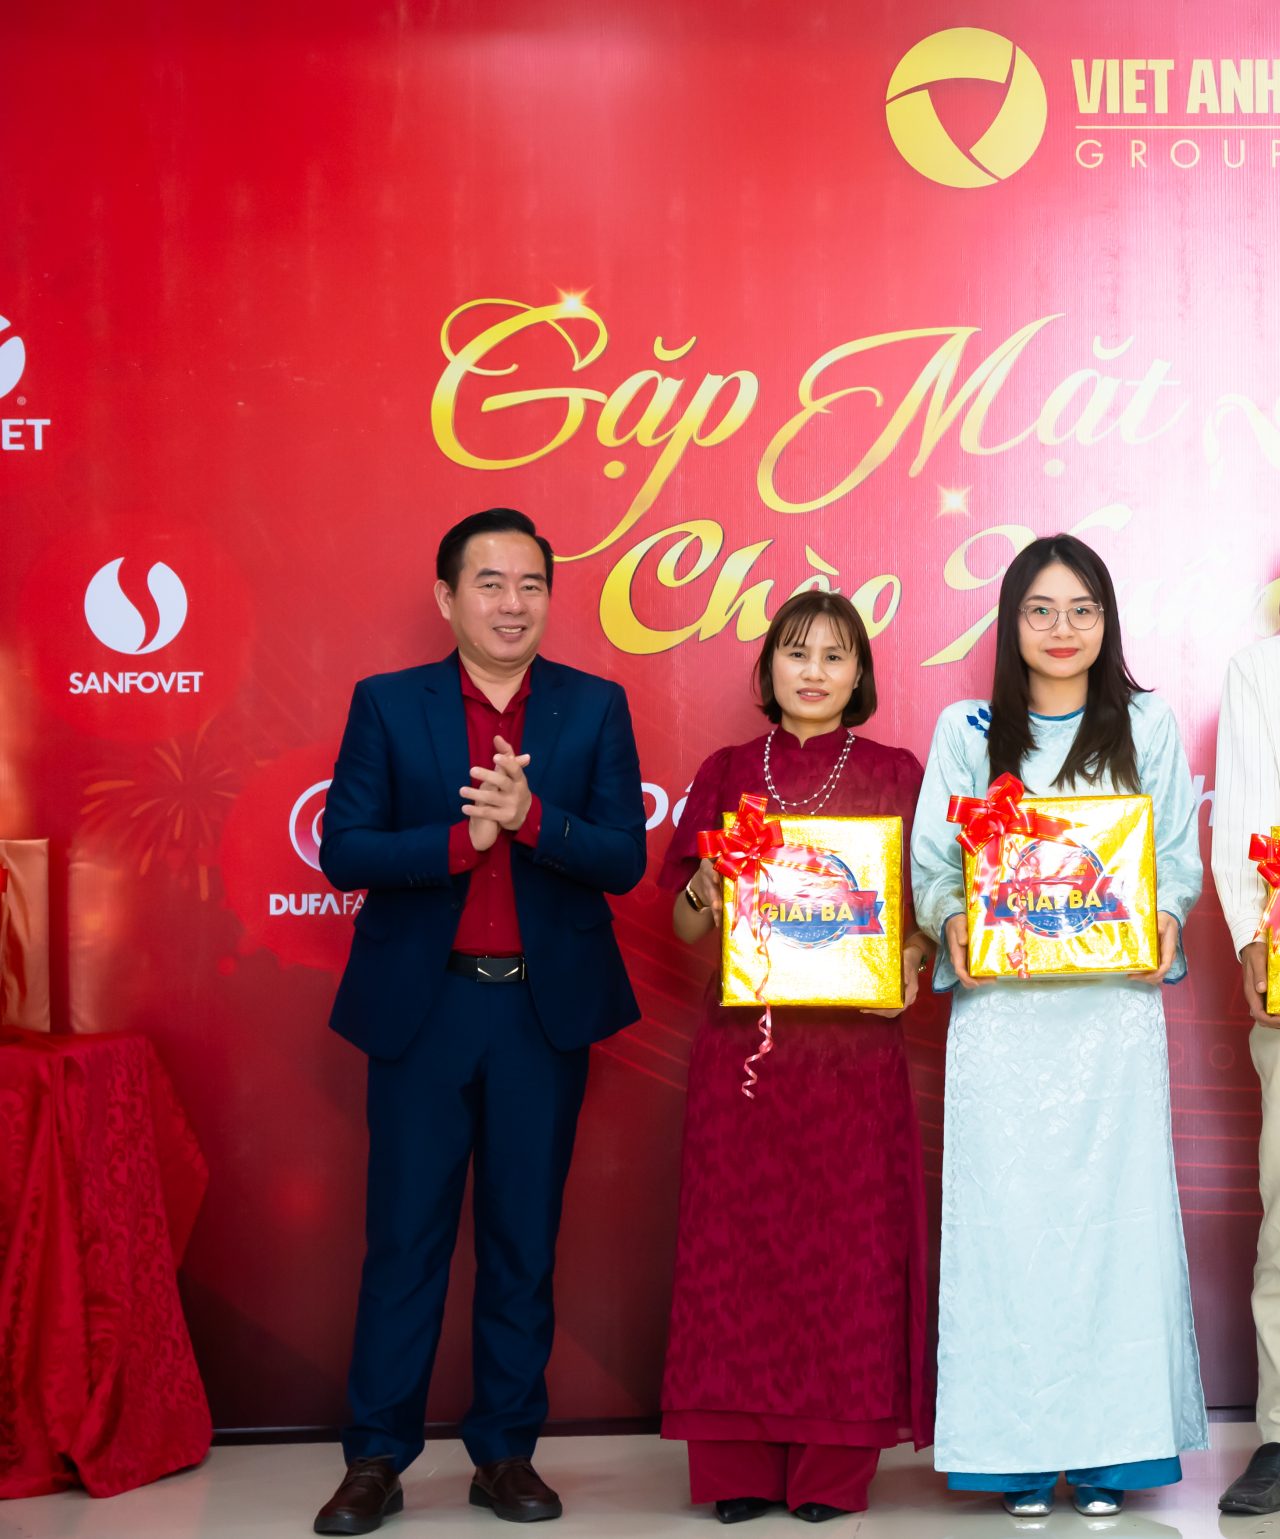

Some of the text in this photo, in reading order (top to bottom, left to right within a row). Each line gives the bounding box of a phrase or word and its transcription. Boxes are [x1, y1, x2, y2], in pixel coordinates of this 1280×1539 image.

[1071, 59, 1175, 114] VIET
[431, 298, 1188, 562] Gặp Mặt
[69, 671, 204, 694] SANFOVET
[1069, 889, 1102, 910] BA
[821, 902, 855, 922] BA
